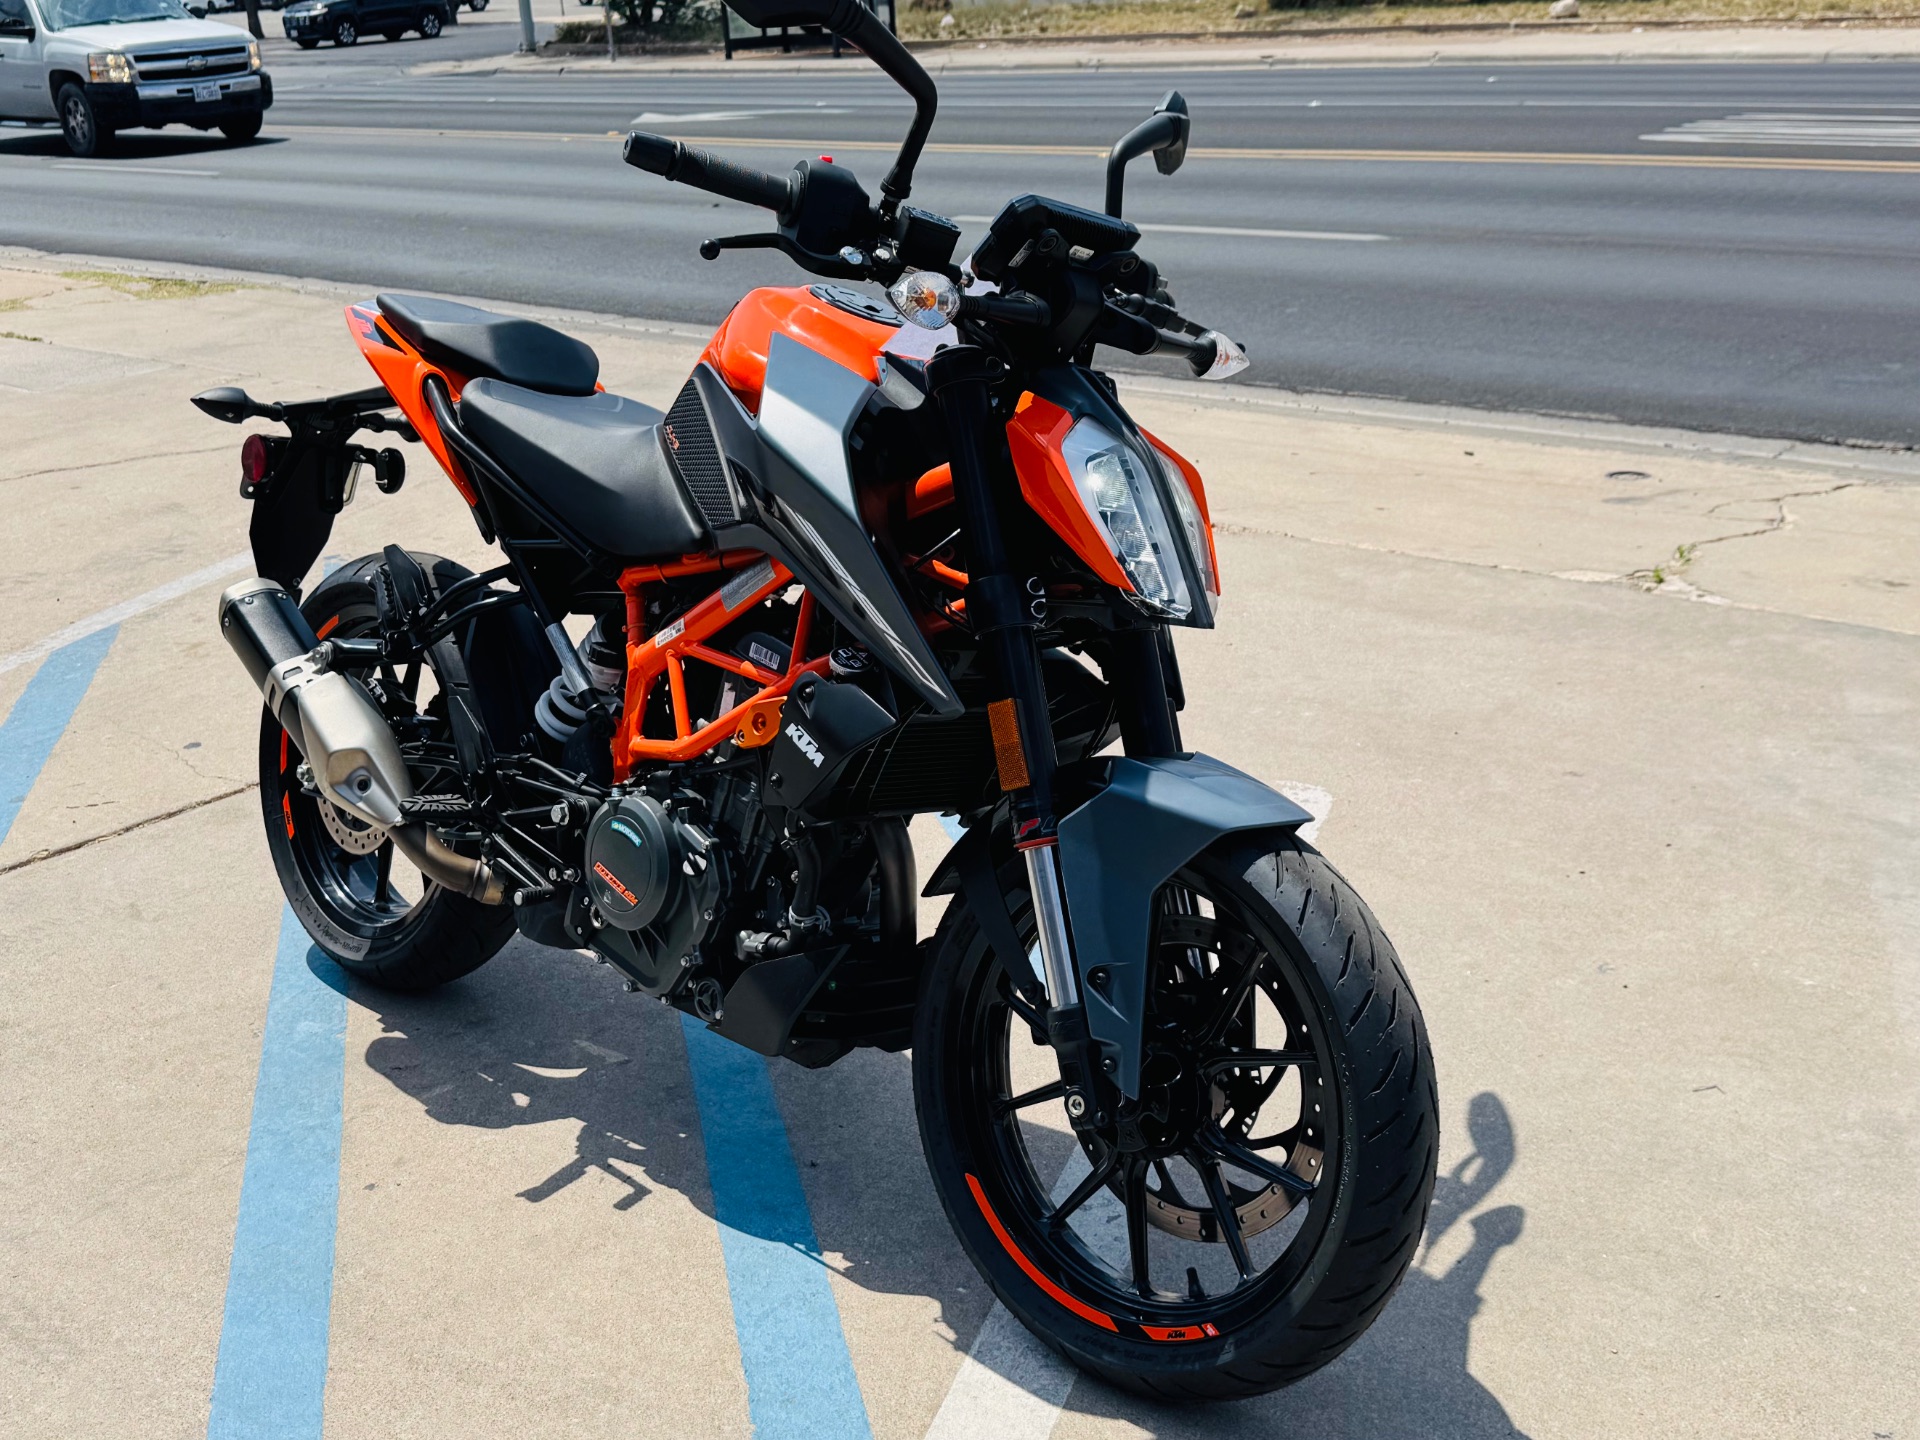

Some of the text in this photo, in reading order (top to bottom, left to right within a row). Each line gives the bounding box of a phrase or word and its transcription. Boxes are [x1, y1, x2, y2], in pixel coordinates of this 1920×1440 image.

[783, 502, 948, 699] 390
[784, 722, 825, 768] KTM
[1167, 1329, 1187, 1339] KTM
